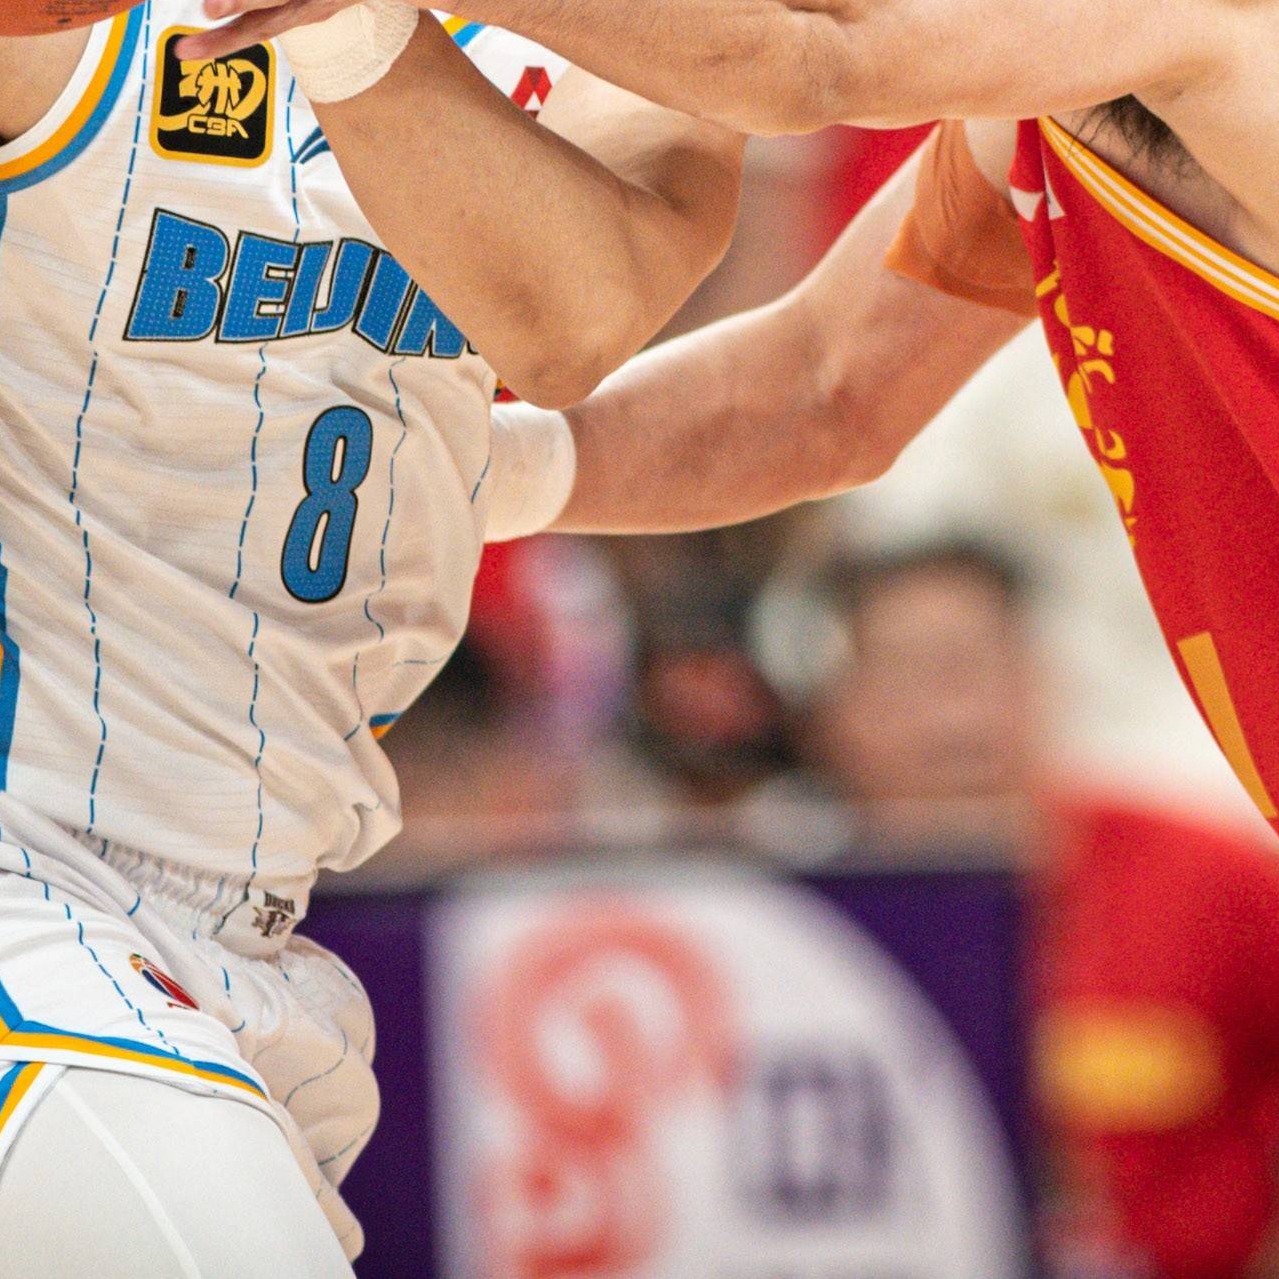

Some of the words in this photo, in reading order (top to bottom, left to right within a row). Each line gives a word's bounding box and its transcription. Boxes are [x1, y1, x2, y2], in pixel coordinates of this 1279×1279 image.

[187, 113, 250, 140] CBA
[123, 207, 478, 360] BEIJIN
[281, 405, 374, 604] 8
